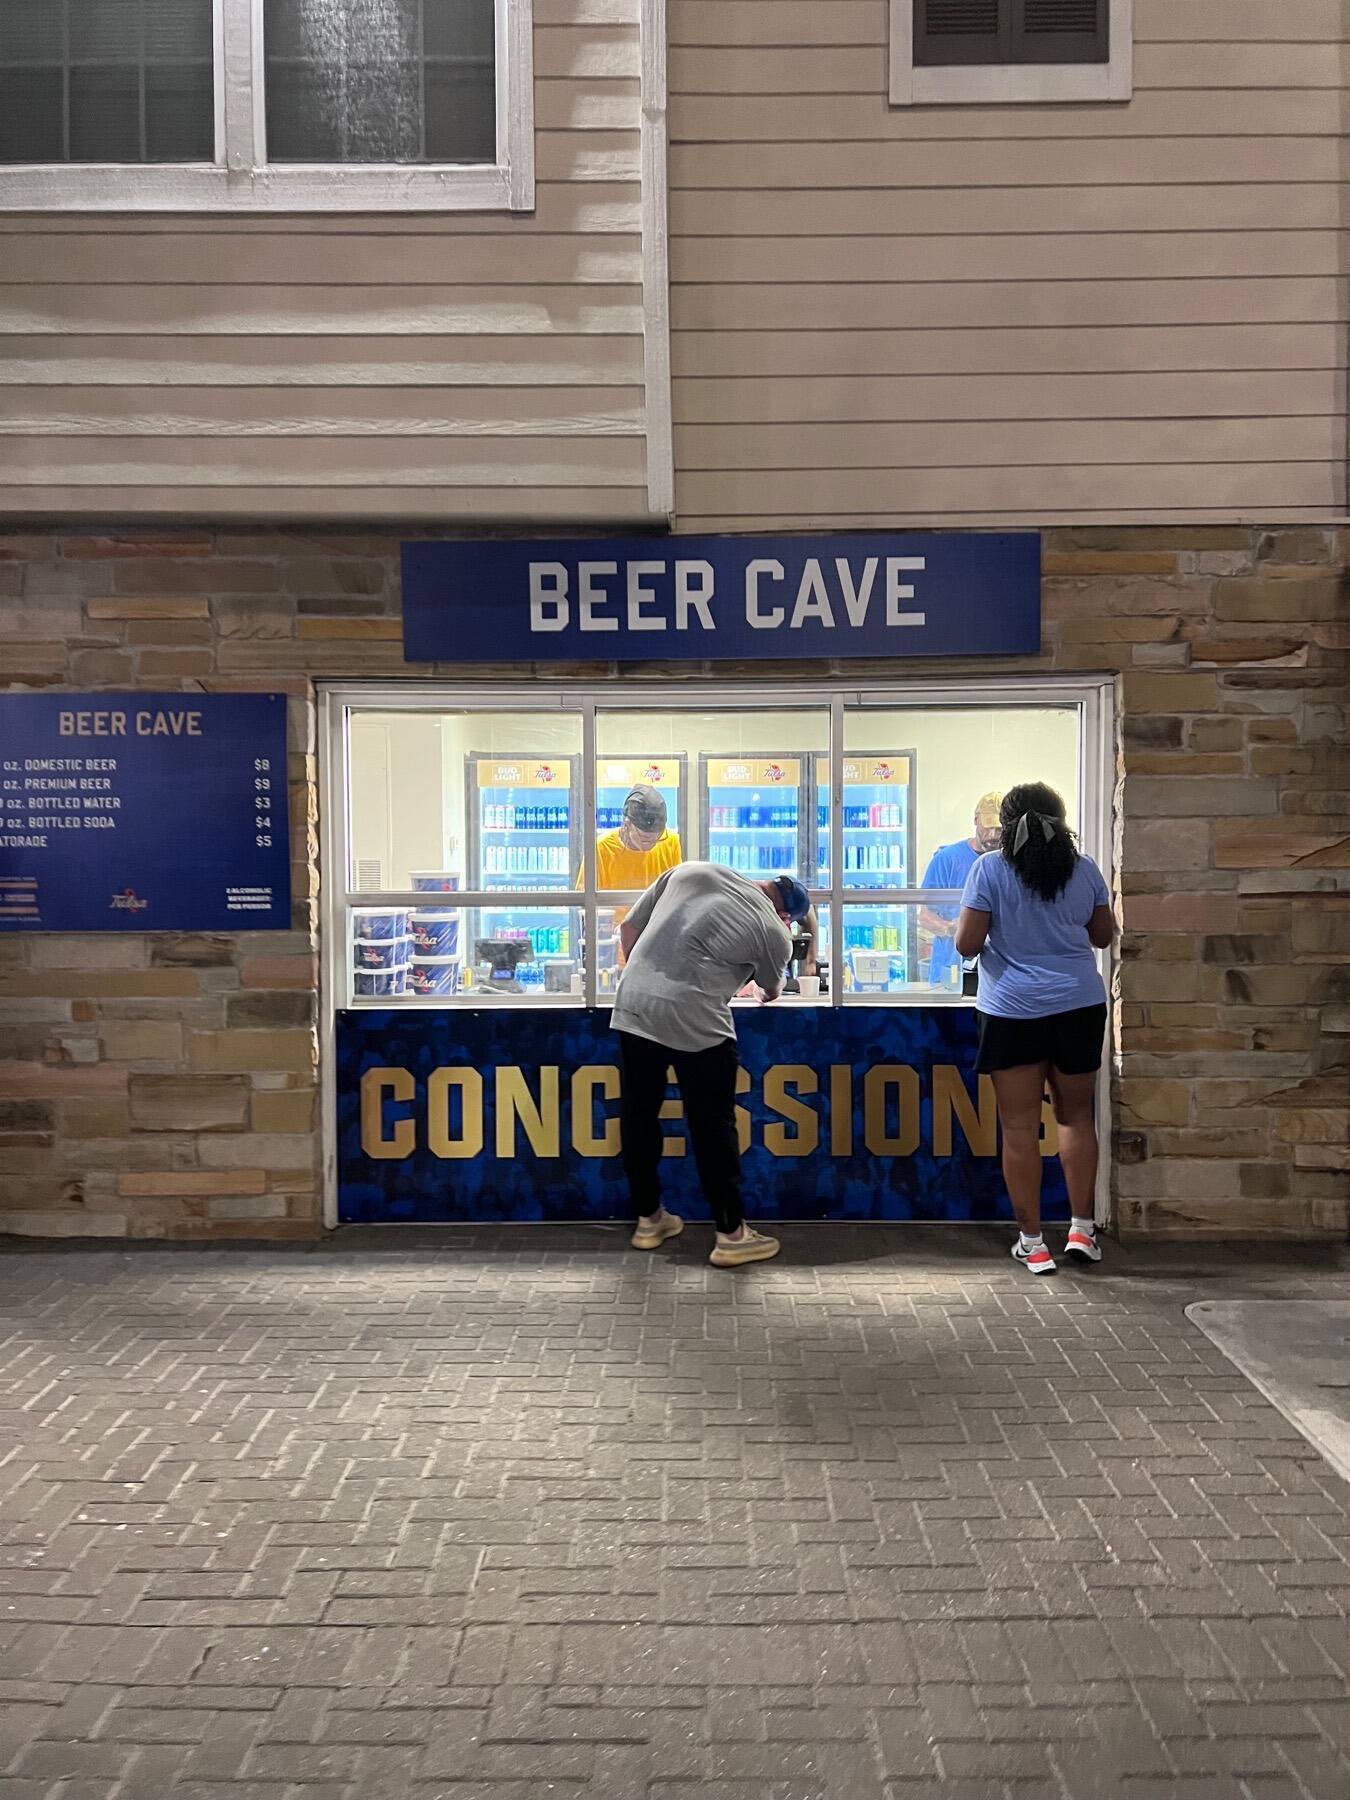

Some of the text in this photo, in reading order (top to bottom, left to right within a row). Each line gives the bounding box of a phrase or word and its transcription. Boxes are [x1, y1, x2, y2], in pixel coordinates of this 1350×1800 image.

[528, 556, 926, 633] BEER CAVE
[59, 711, 202, 735] BEER CAVE
[3, 758, 270, 771] oz. DOMESTIC BEER $8
[3, 778, 271, 791] oz. PREMIUM BEER $9
[28, 797, 80, 808] BOTTLED
[83, 797, 121, 808] WATER
[255, 797, 271, 809] $3
[28, 816, 80, 828] BOTTLED
[84, 816, 116, 828] SODA
[255, 816, 271, 828] $4
[0, 835, 272, 847] ATORADE $5
[360, 1064, 1060, 1159] CONCSION
